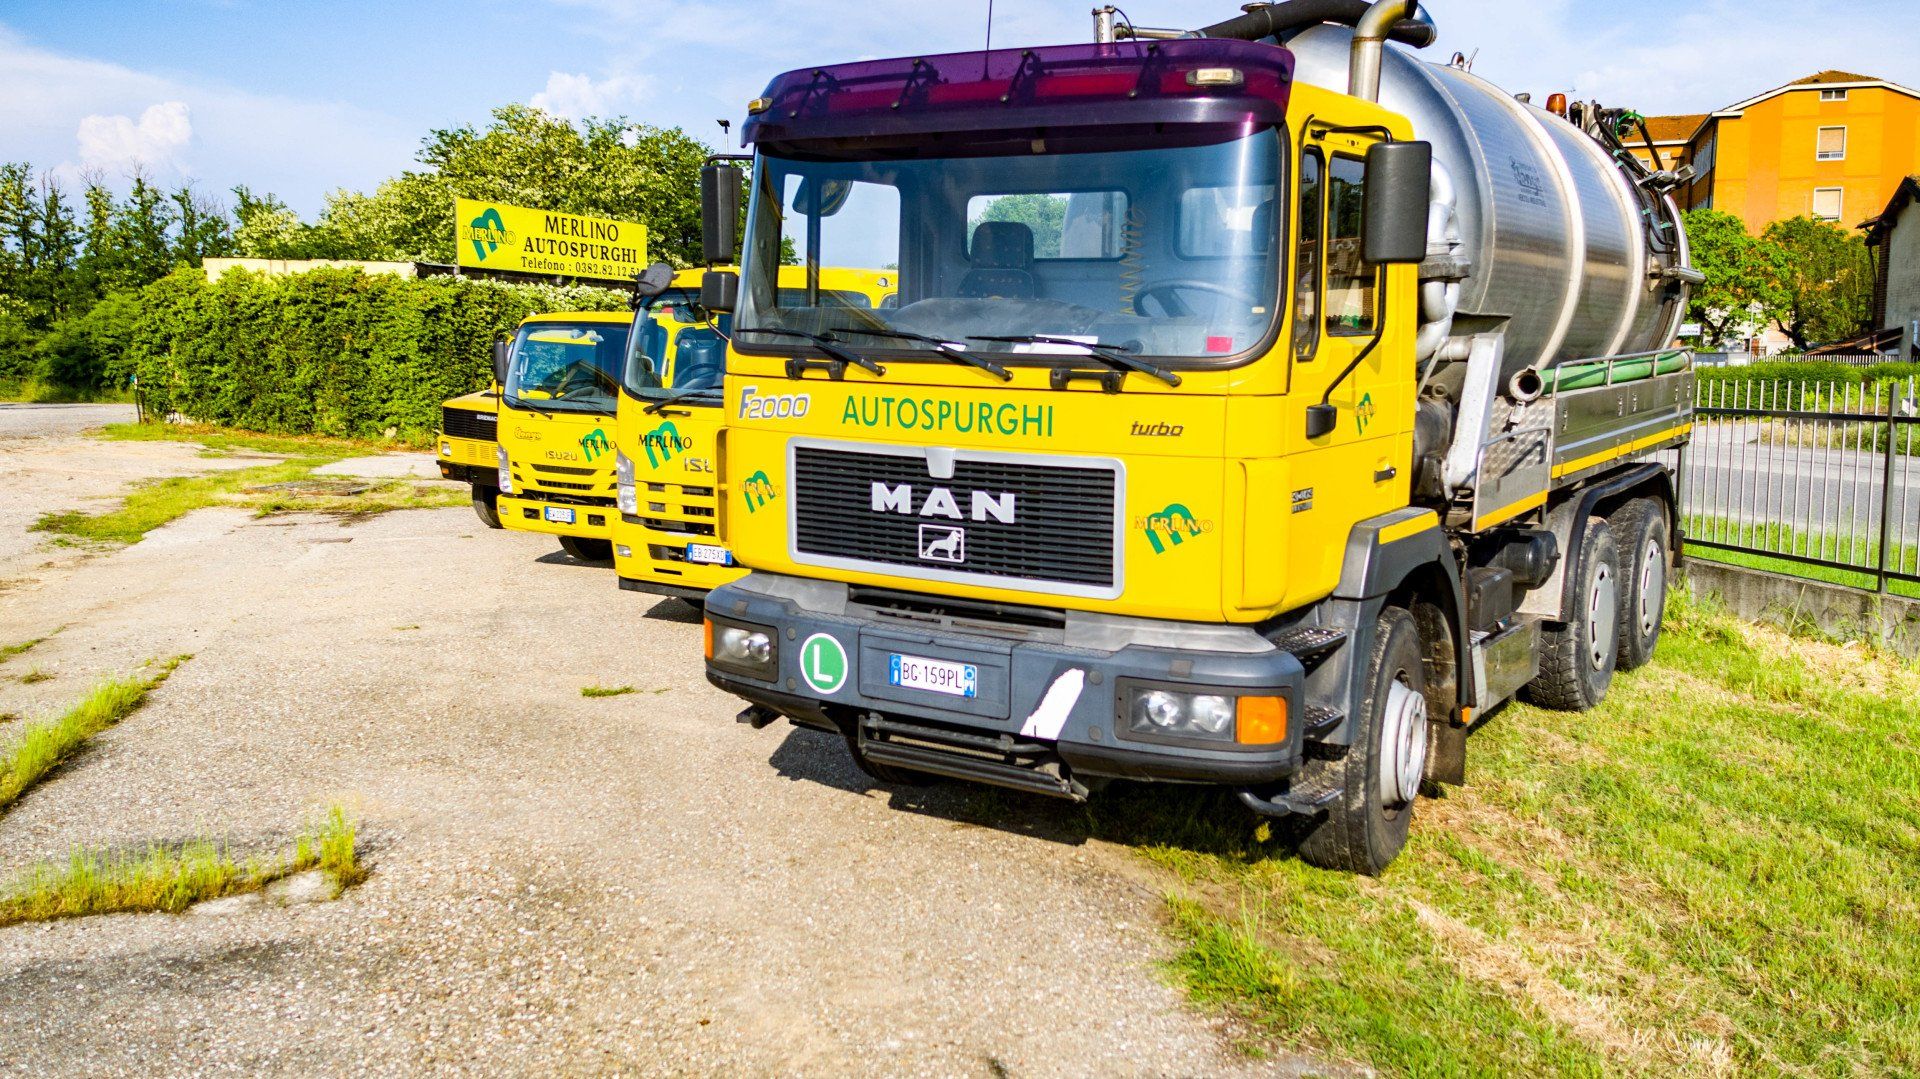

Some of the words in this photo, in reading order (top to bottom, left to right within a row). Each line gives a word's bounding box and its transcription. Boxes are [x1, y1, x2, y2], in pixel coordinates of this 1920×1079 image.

[463, 225, 517, 246] MERLINO
[545, 215, 619, 242] MERLINO
[524, 236, 638, 264] AUTOSPURGHI
[521, 256, 565, 272] Telefono
[738, 386, 810, 419] F2000
[842, 395, 1054, 437] AUTOSPURGHI
[1130, 420, 1185, 437] turbo
[577, 438, 617, 450] MERLINO
[638, 433, 693, 451] MERLINO
[545, 450, 578, 462] ISUZU
[871, 481, 1016, 525] MAN
[1134, 516, 1214, 535] MERLINO
[814, 643, 834, 683] L
